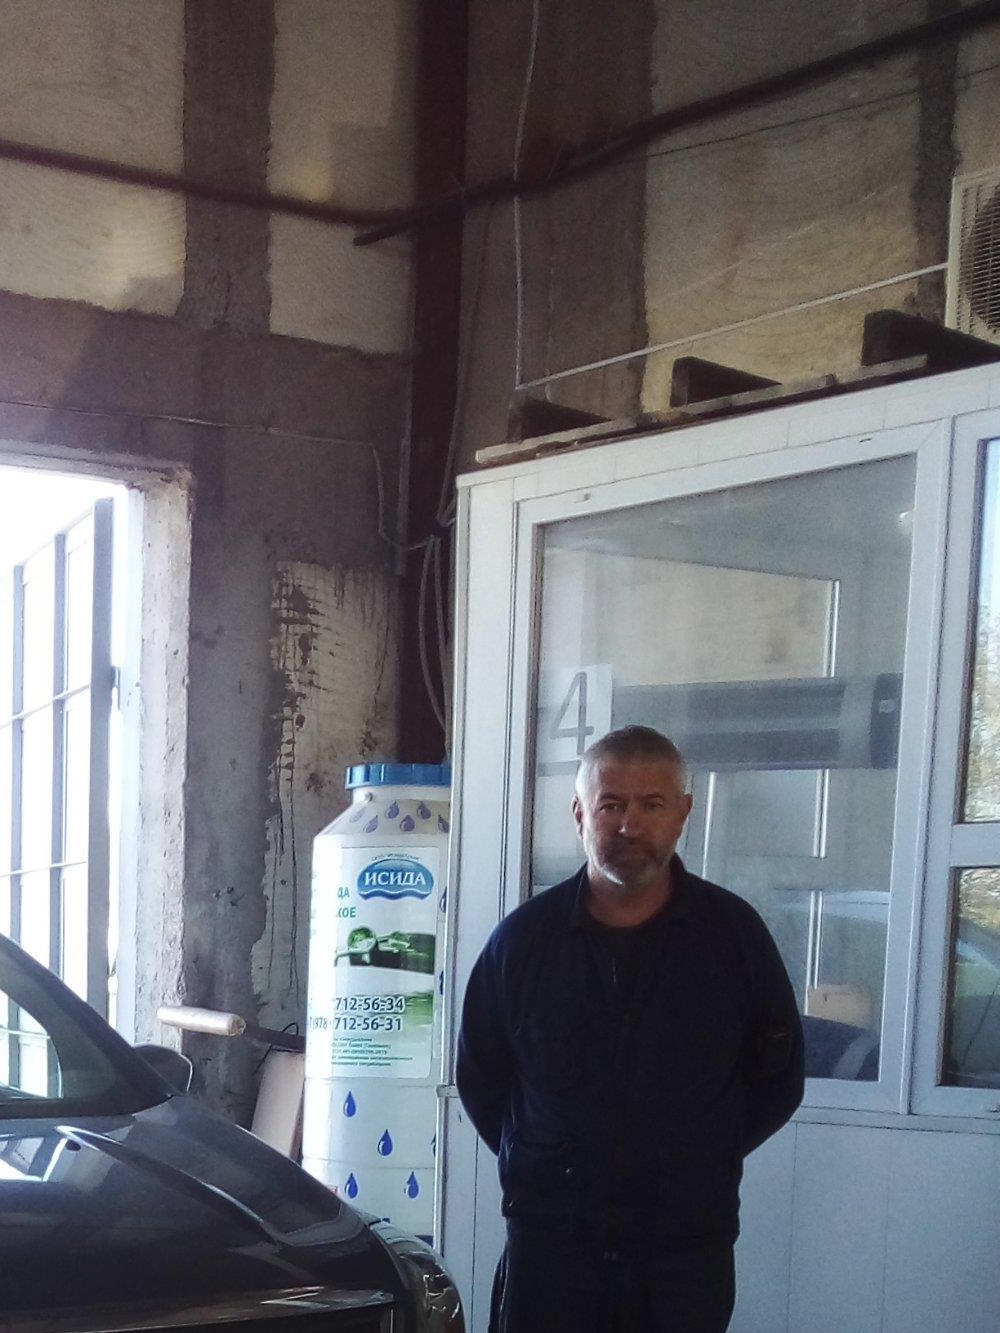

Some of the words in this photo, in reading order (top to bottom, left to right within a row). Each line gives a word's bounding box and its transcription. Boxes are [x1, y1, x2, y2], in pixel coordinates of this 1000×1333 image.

[548, 670, 595, 756] 4
[364, 871, 426, 886] ИСИДА
[335, 997, 404, 1011] 712-56-34
[334, 1017, 402, 1031] 712-56-31
